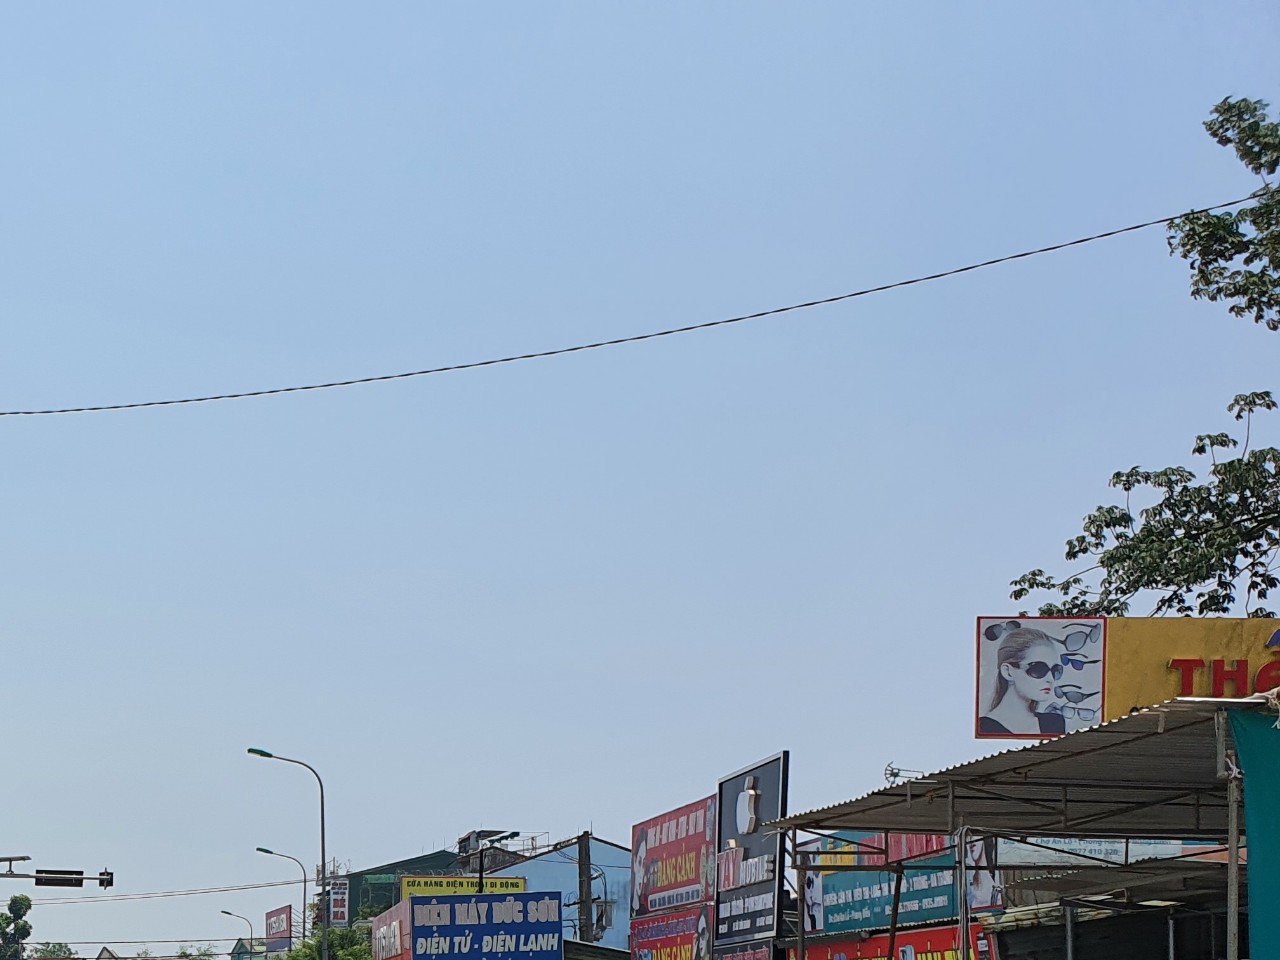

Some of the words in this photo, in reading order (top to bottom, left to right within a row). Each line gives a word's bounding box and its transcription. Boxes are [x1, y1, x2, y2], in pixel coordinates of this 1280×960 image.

[446, 880, 464, 888] ĐIỆN
[490, 880, 499, 888] DI
[500, 880, 520, 889] ĐỘNG
[414, 899, 451, 931] ĐIỆN
[455, 898, 489, 925] MÁY
[492, 896, 523, 924] ĐỨC
[527, 896, 559, 923] SƠN
[416, 932, 452, 959] ĐIỆN
[453, 929, 473, 953] TỬ
[482, 930, 517, 957] ĐIỆN
[519, 933, 560, 957] LẠNH
